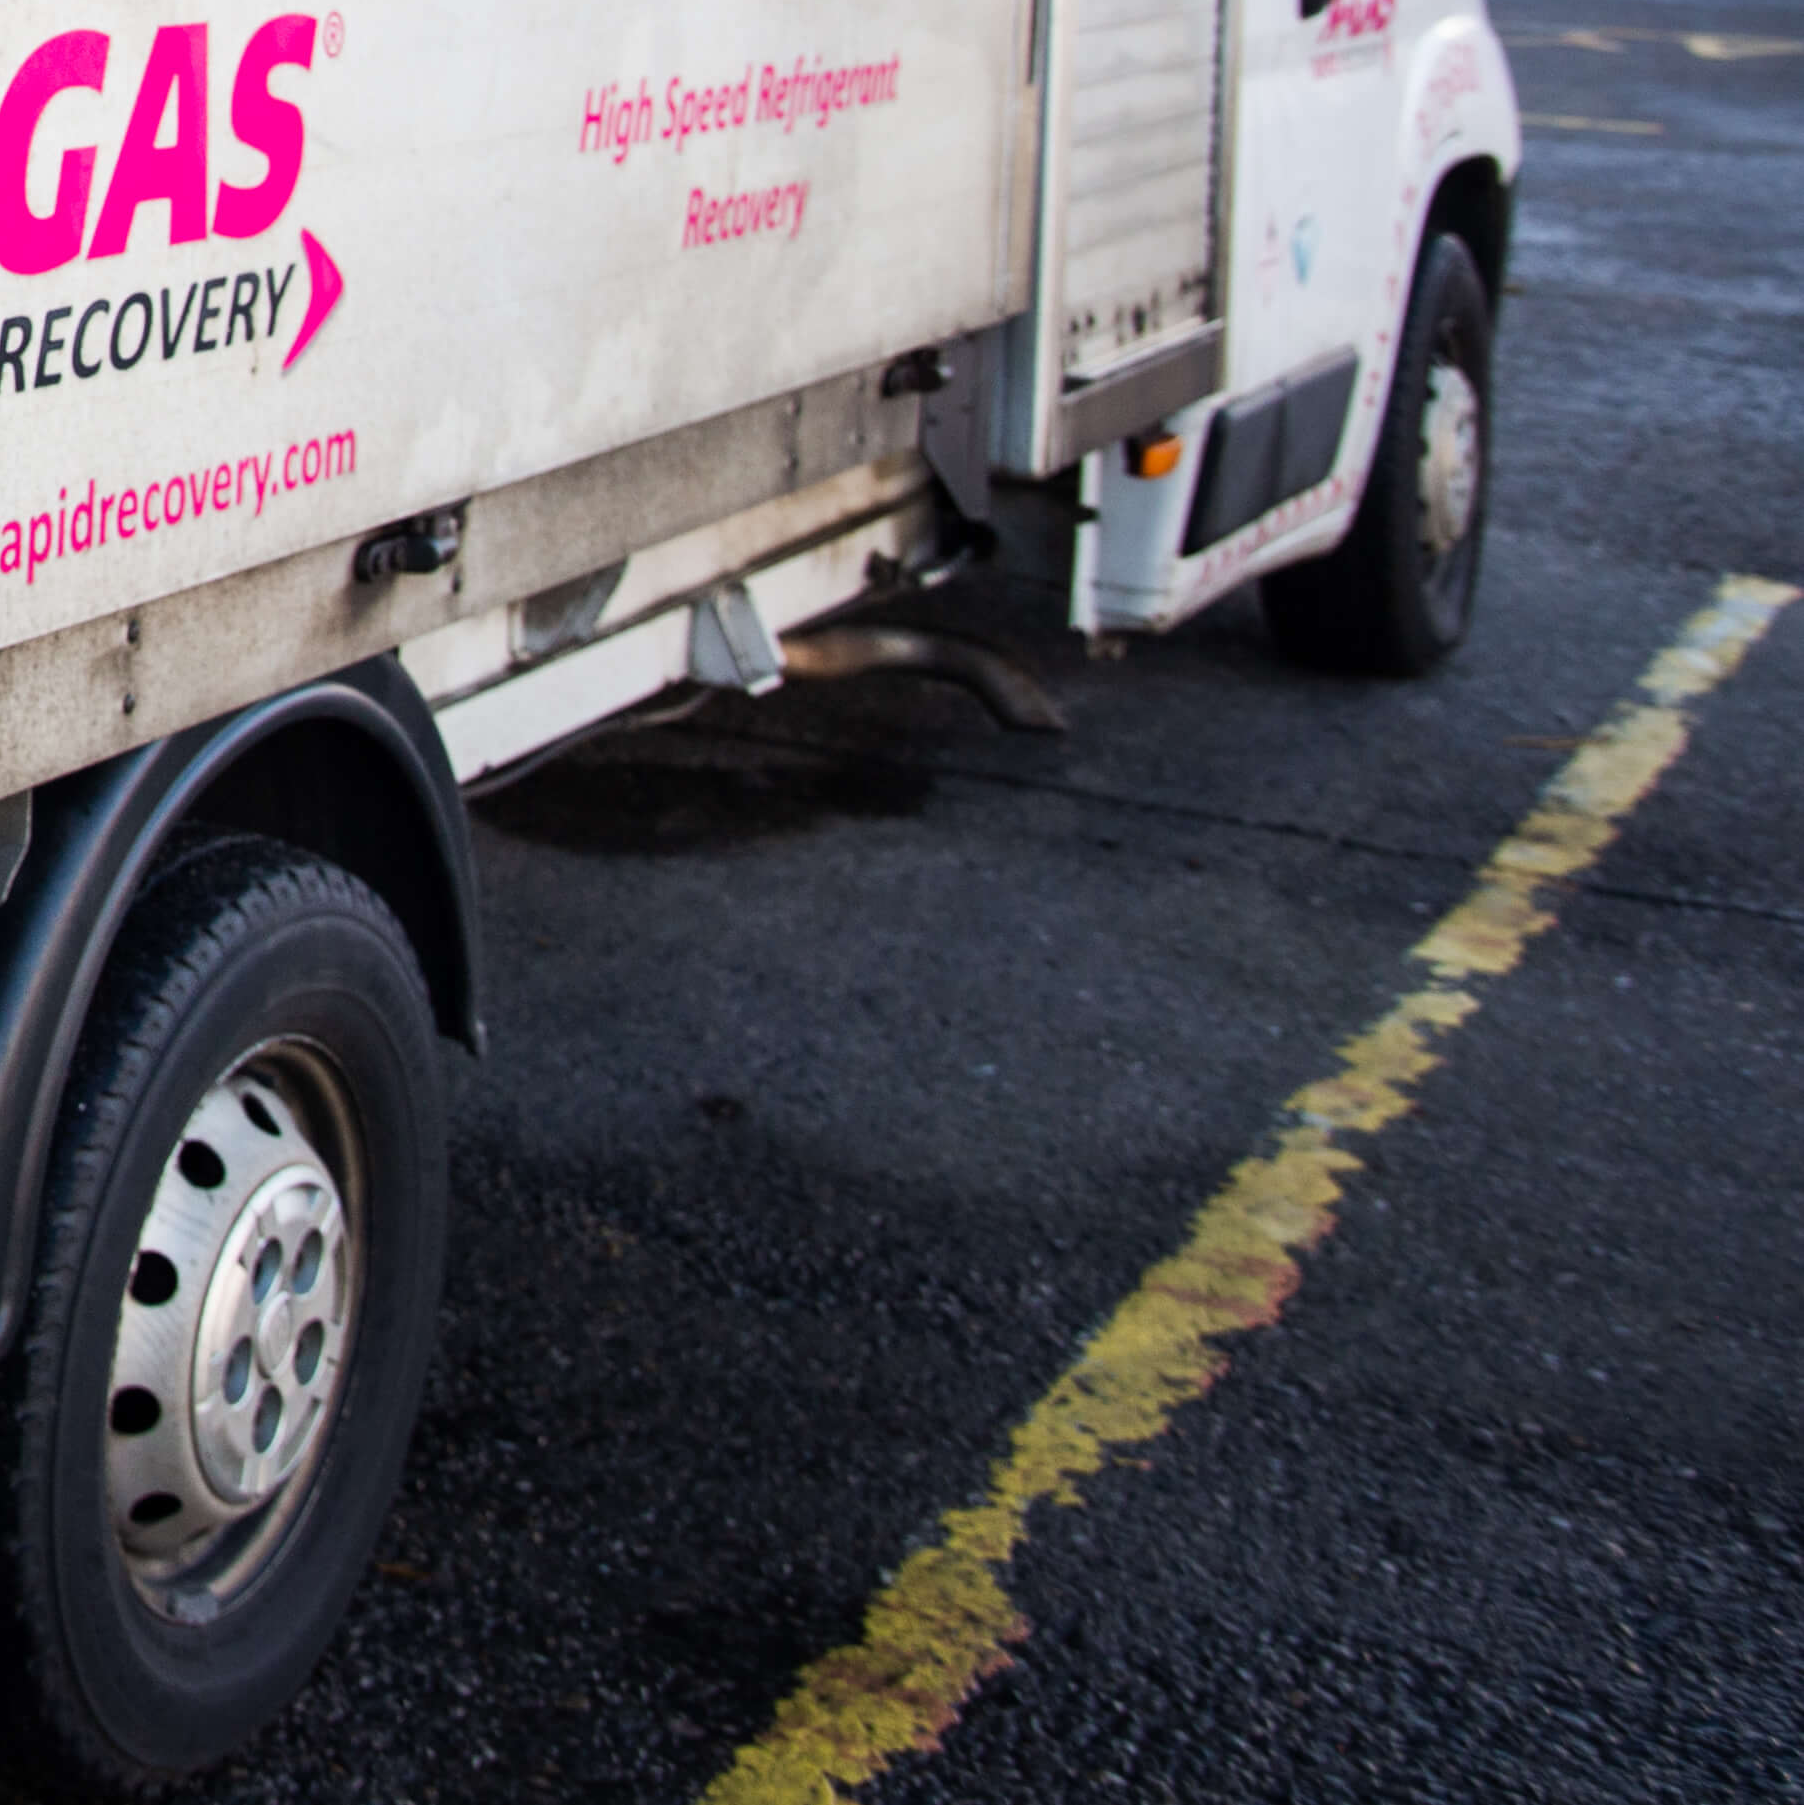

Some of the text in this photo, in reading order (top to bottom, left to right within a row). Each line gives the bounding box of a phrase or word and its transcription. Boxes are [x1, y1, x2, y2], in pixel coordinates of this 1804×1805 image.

[579, 49, 901, 166] High Speed Refrigerant
[681, 179, 811, 251] Recovery
